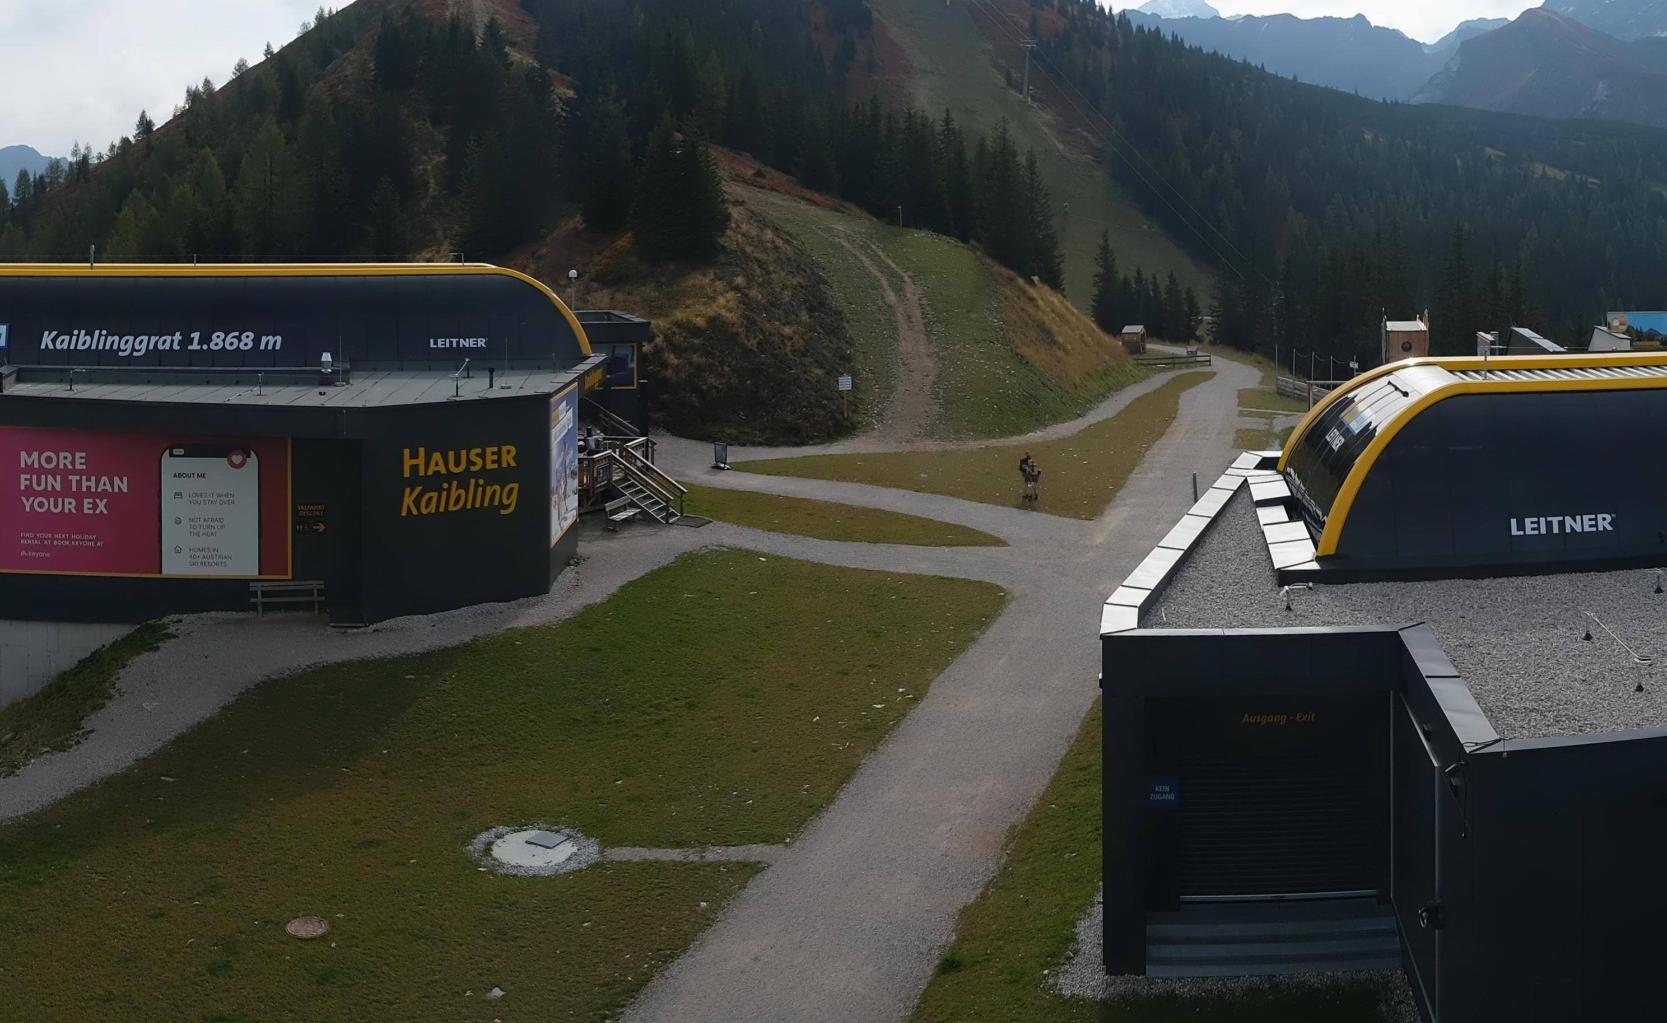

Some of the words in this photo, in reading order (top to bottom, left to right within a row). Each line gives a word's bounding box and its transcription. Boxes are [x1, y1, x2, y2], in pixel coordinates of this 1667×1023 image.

[40, 329, 182, 357] Kaiblinggrat
[187, 331, 254, 350] 1.868
[259, 335, 282, 350] m
[430, 337, 487, 348] LEITNER
[20, 451, 86, 469] MORE
[403, 445, 517, 477] HAUSER
[20, 474, 61, 491] FUN
[69, 475, 128, 493] THAN
[21, 497, 76, 513] YOUR
[83, 498, 108, 514] EX
[401, 478, 519, 516] Kaibling
[1511, 513, 1614, 536] LEITNER
[1242, 713, 1287, 725] Ausgang
[1296, 711, 1316, 722] Exit
